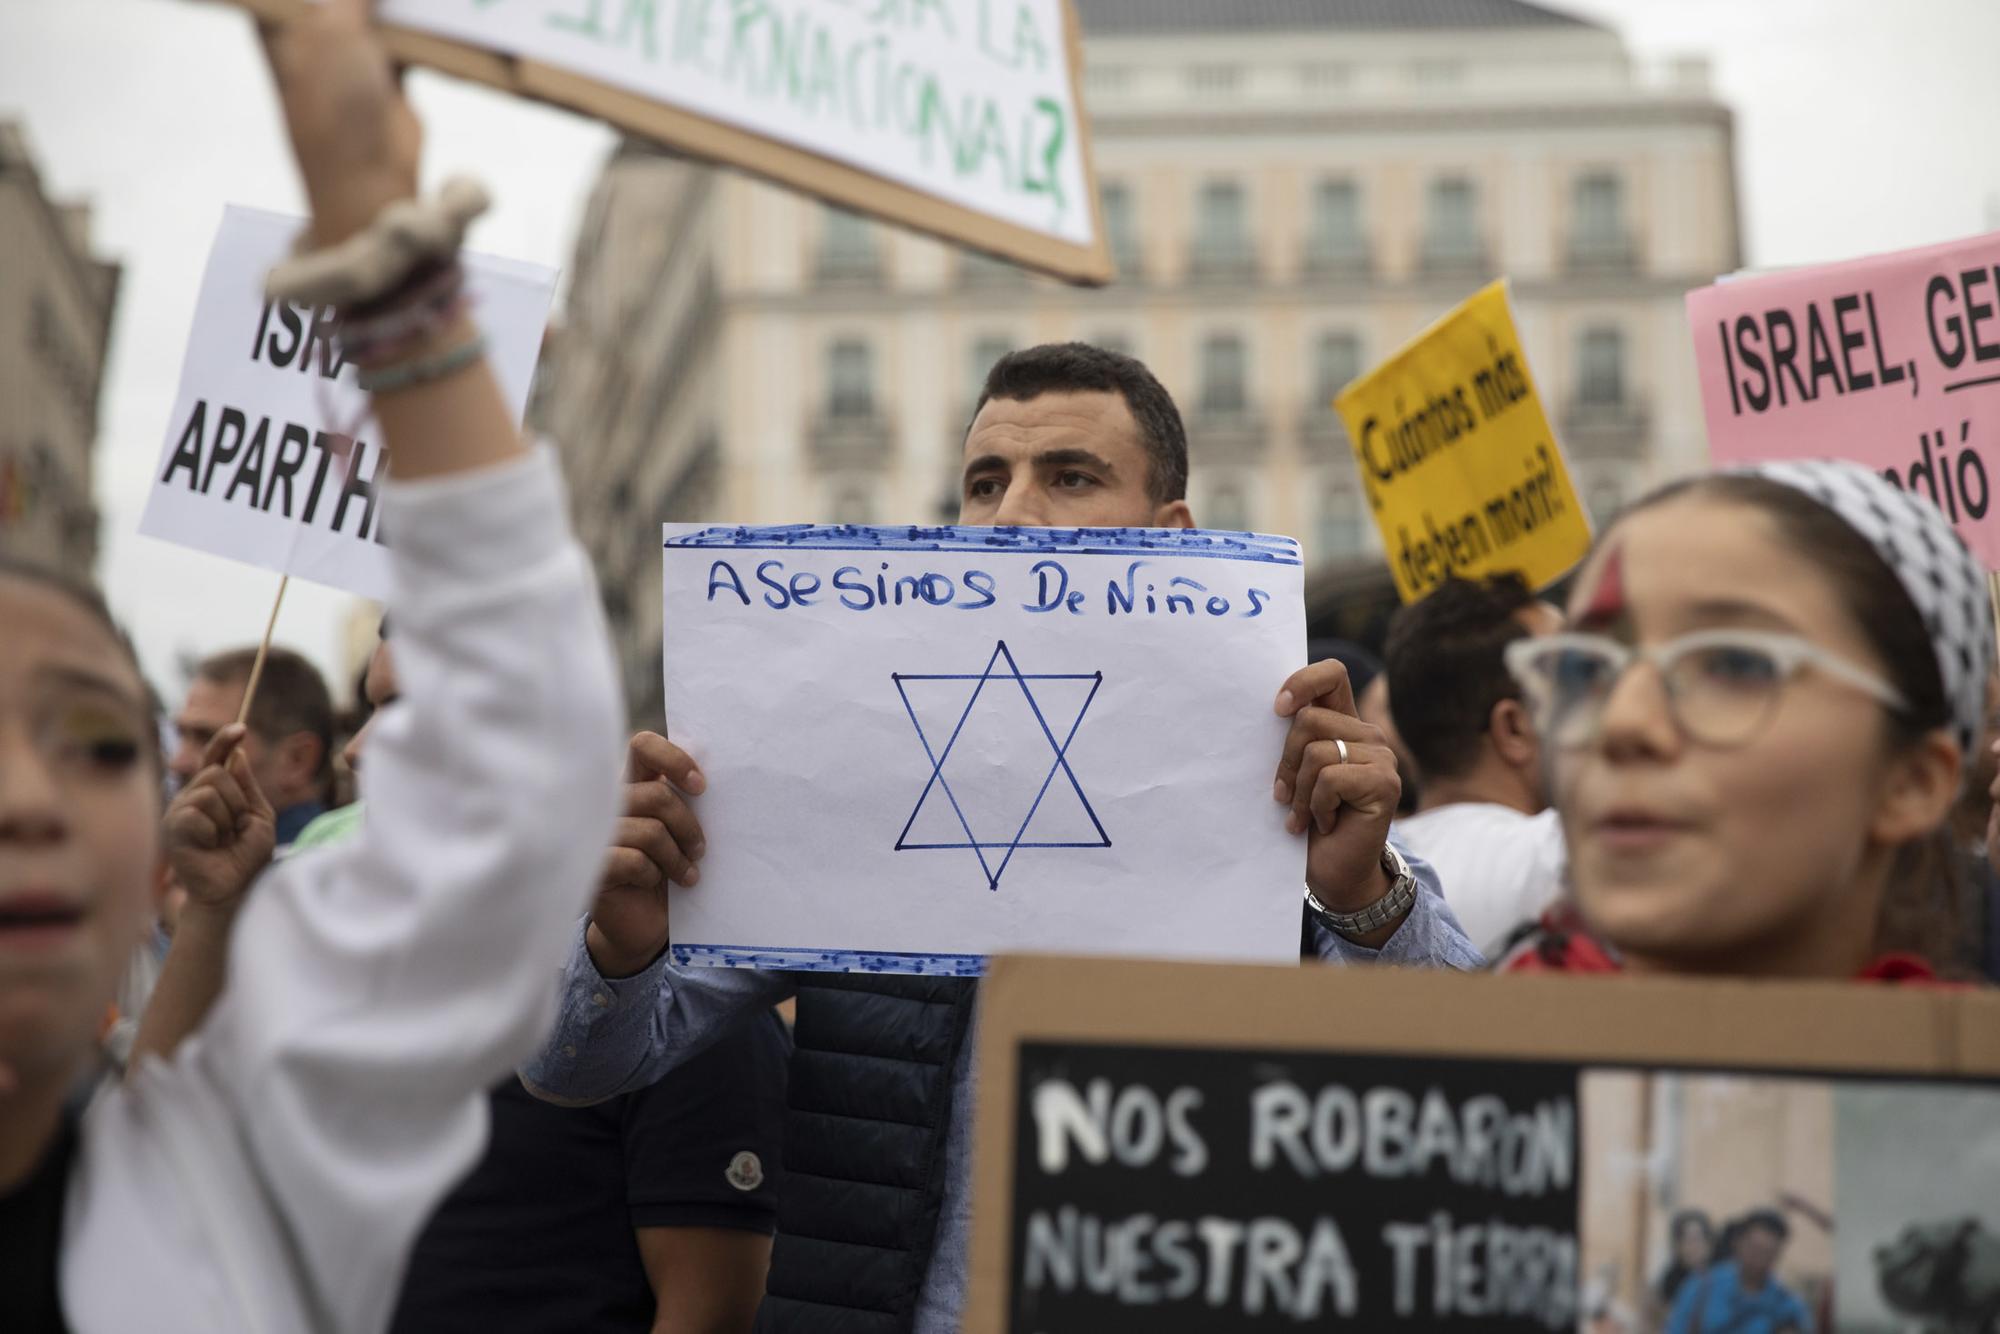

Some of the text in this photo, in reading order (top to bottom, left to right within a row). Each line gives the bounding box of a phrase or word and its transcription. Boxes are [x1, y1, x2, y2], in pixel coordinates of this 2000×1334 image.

[1719, 264, 2000, 416] ISRAEL, GE
[161, 399, 390, 546] APARTH
[1021, 559, 1086, 617] De
[1107, 560, 1271, 618] Niños
[1396, 508, 1490, 594] deben
[1033, 1080, 1573, 1196] NOS ROBARON
[1022, 1206, 1358, 1320] NUESTRA
